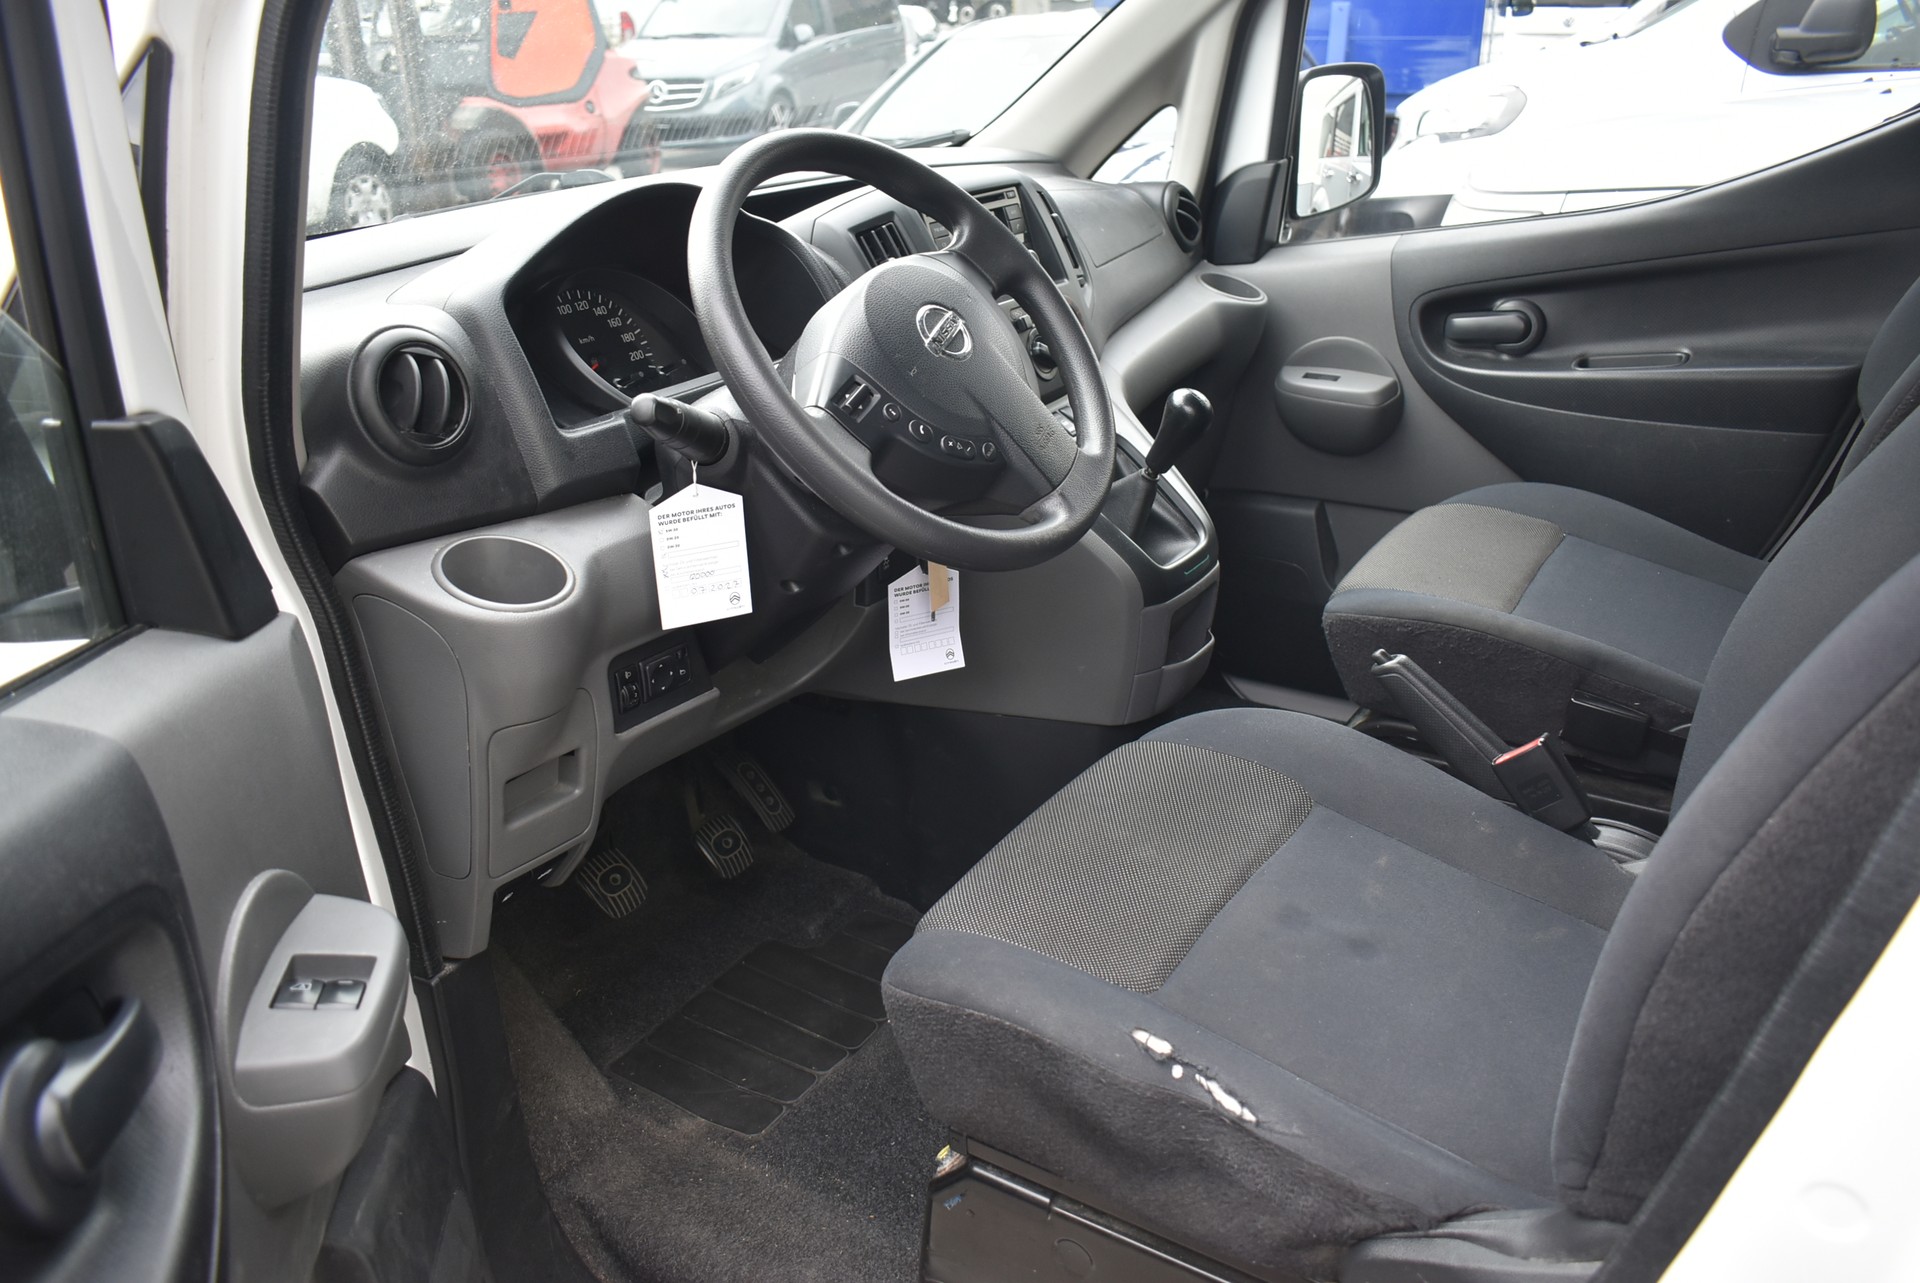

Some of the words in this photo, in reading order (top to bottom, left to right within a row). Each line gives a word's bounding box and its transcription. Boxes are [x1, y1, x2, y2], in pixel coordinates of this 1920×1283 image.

[557, 304, 572, 315] 100
[574, 301, 589, 311] 120
[593, 306, 608, 316] 140
[607, 317, 622, 328] 160
[931, 314, 960, 349] NISSAN
[578, 335, 596, 345] km/h
[620, 332, 635, 343] 180
[629, 350, 644, 361] 200
[671, 510, 694, 518] MOTOR
[715, 503, 736, 511] AUTOS
[657, 518, 681, 526] WURDE
[682, 513, 708, 523] BEFÜLLT
[905, 583, 922, 591] MOTOR
